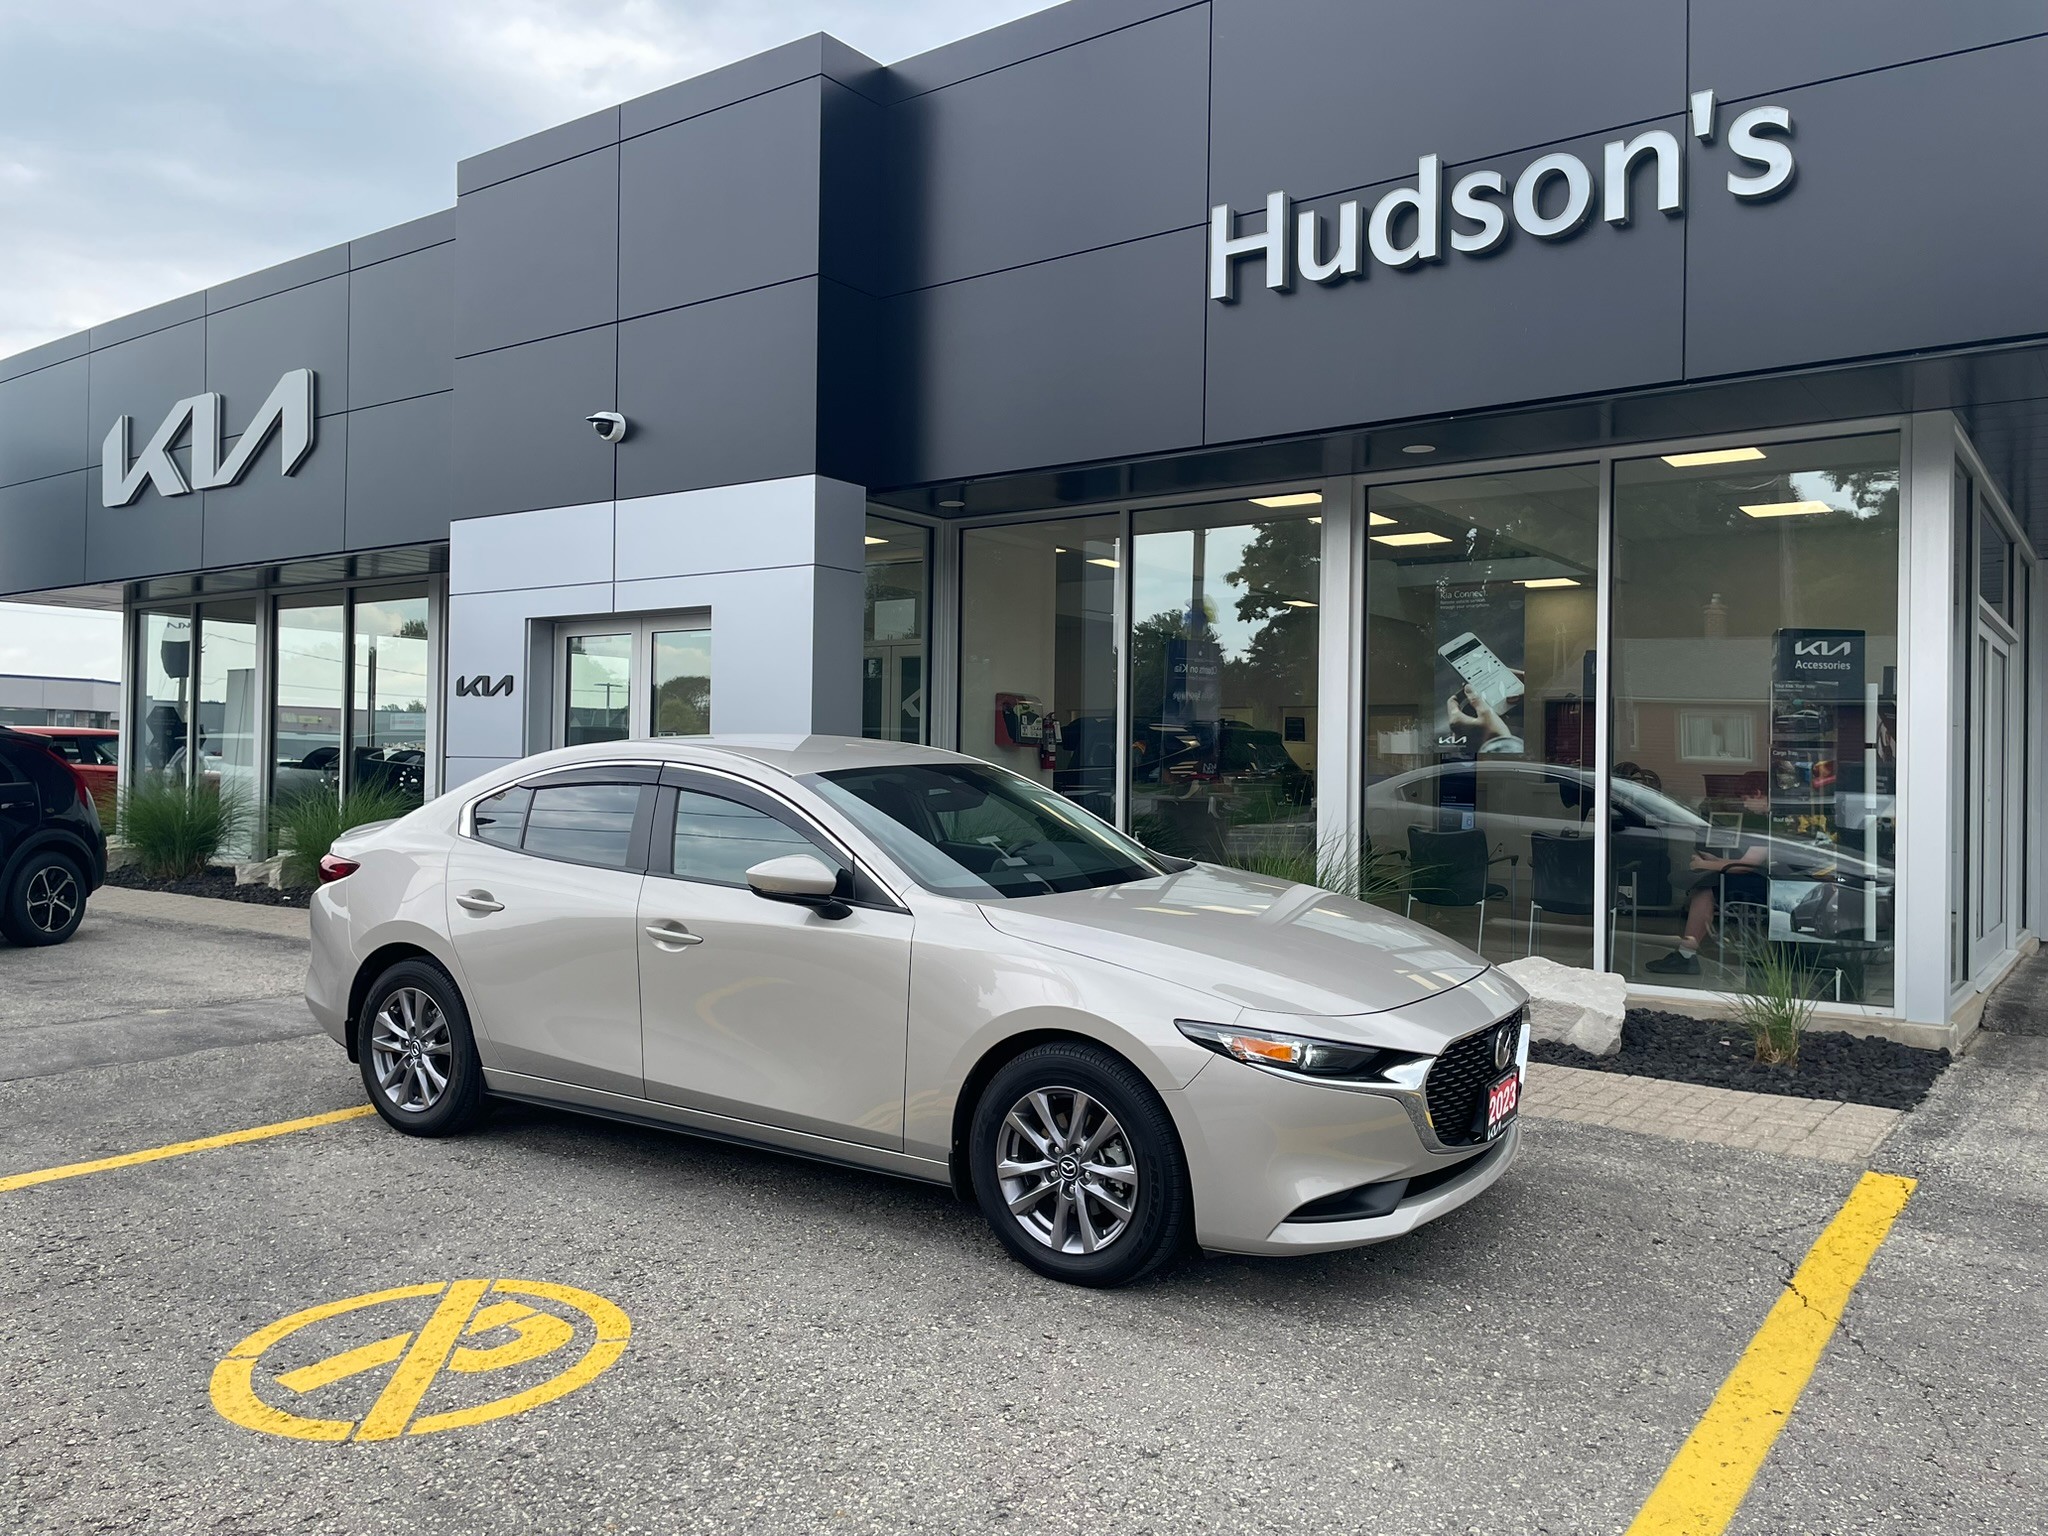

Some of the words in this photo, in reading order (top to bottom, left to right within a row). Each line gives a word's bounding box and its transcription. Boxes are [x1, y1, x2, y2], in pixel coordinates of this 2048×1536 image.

[1210, 88, 1796, 302] Hudson's
[102, 368, 315, 507] KIA
[1795, 641, 1851, 655] KIA
[1795, 660, 1851, 670] Accessories
[456, 675, 513, 697] KIA
[1438, 735, 1467, 744] KIA
[1488, 1081, 1517, 1126] 2023
